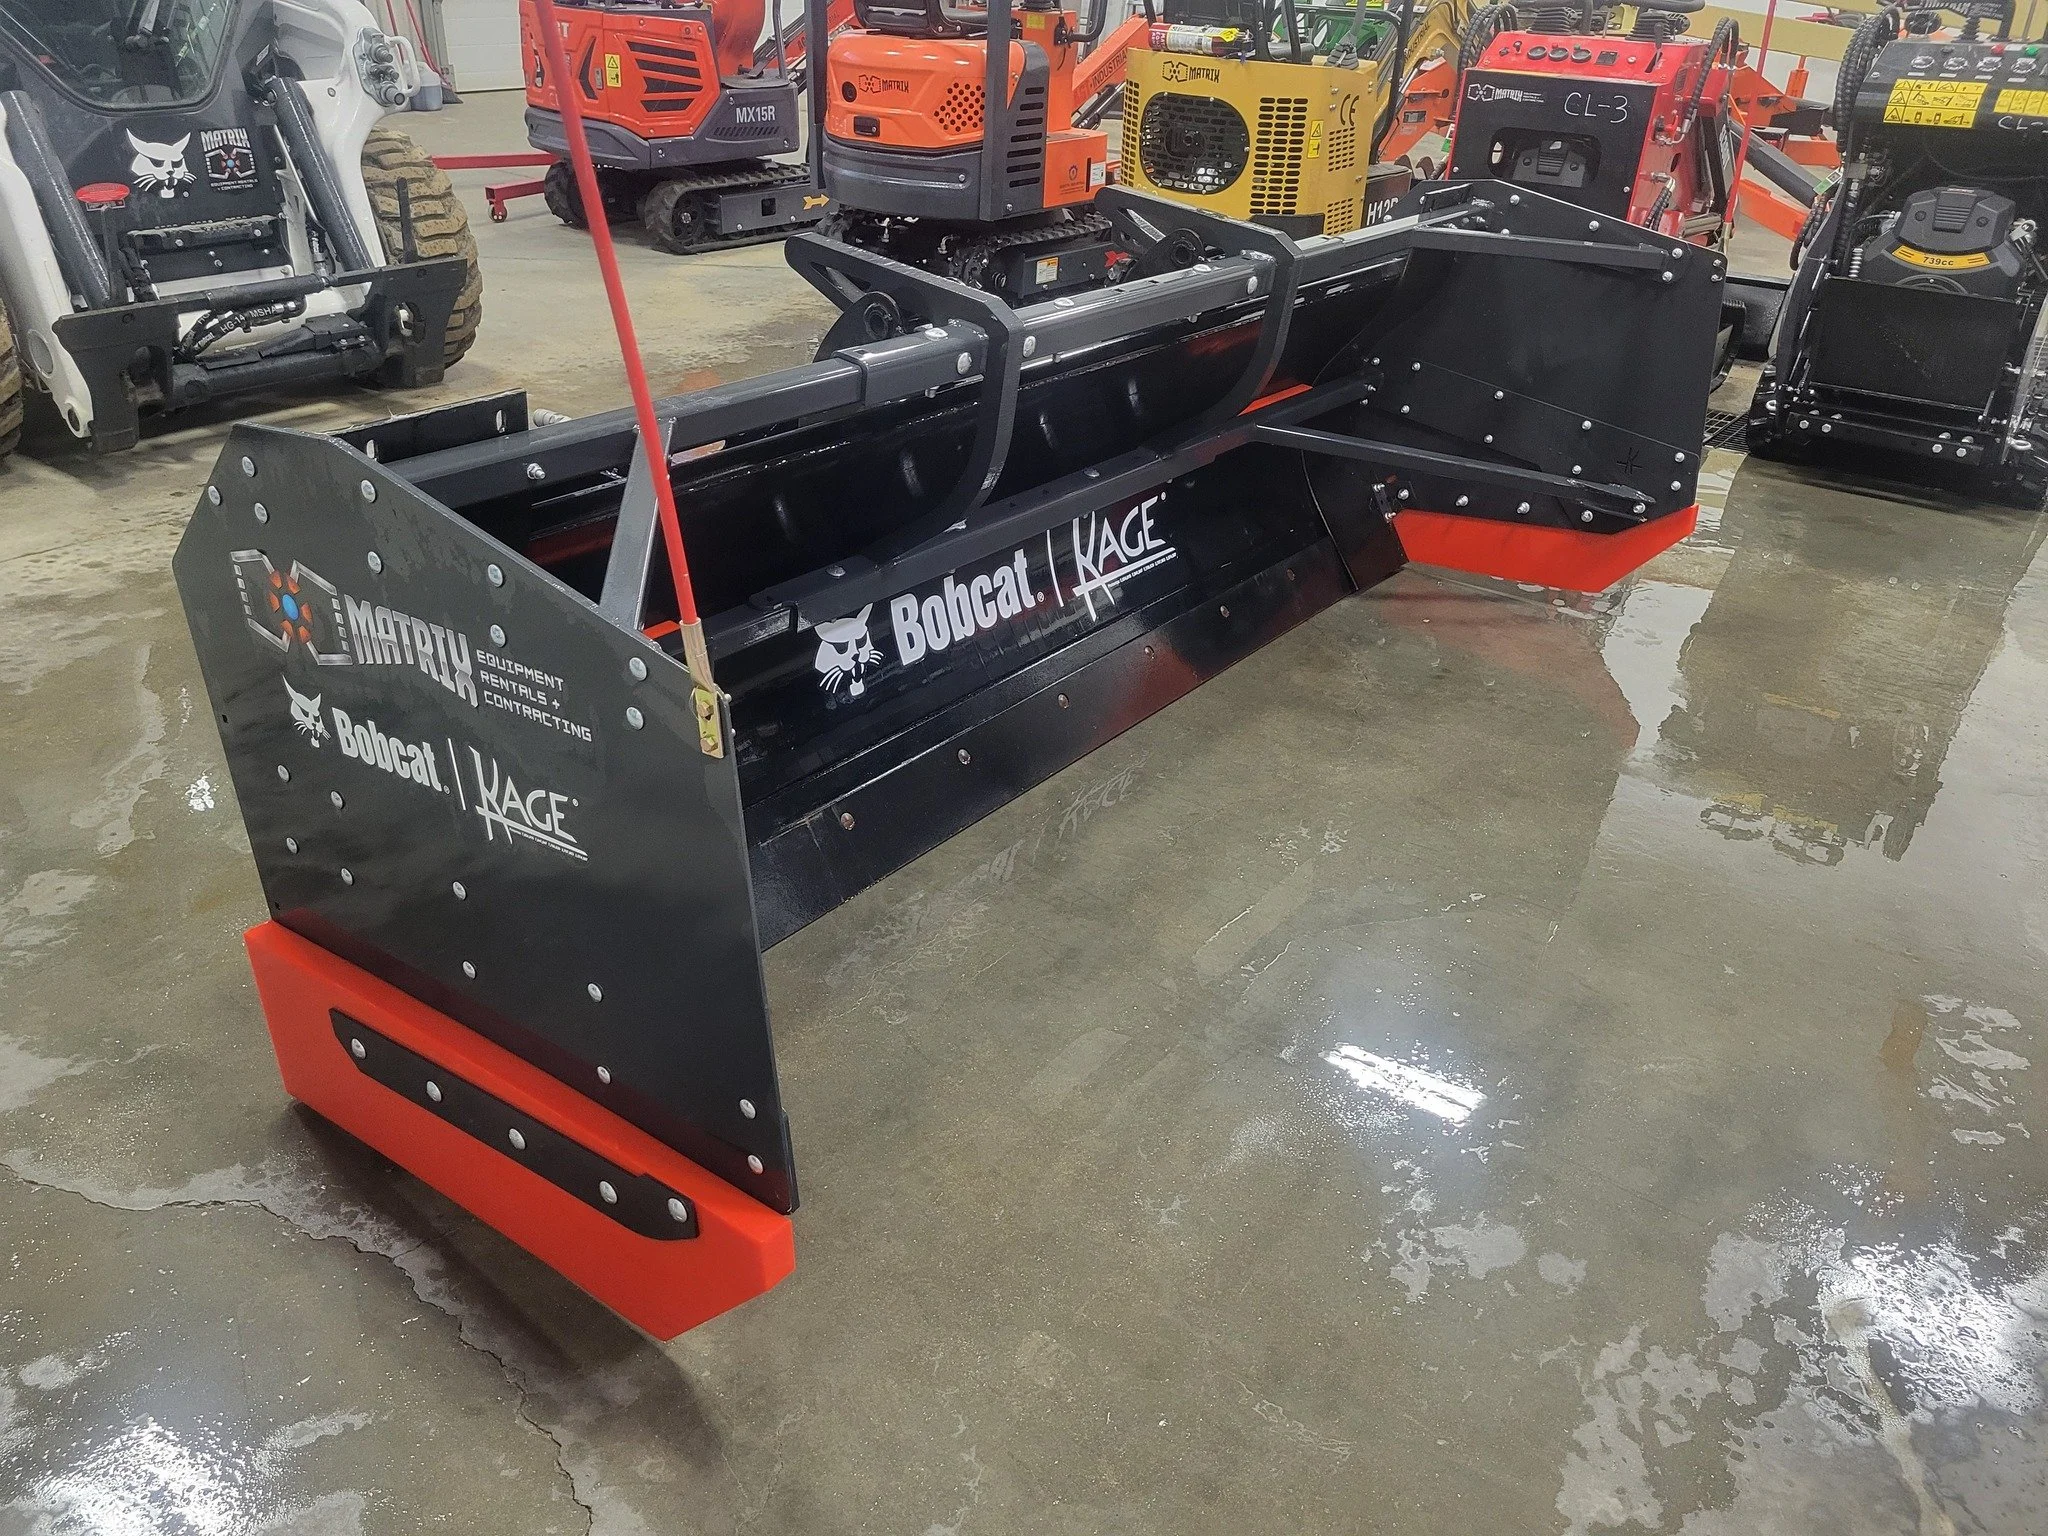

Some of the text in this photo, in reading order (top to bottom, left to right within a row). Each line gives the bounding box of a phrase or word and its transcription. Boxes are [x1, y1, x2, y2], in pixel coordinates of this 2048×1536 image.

[881, 79, 909, 93] MATRIX
[1188, 66, 1220, 83] MATRIX
[1340, 93, 1360, 126] CE
[1494, 88, 1523, 103] MATRIX
[1564, 92, 1628, 124] CL-3
[736, 105, 776, 124] MX15R
[1998, 115, 2048, 134] CL-
[200, 127, 251, 152] MATRIX
[1923, 256, 1954, 266] 739cc
[890, 495, 1168, 666] Bobcat KAGE
[344, 593, 479, 708] MATRIX
[476, 649, 564, 691] EQUIPMENT
[480, 670, 548, 706] RENTALS
[483, 690, 592, 742] CONTRACTING
[331, 706, 579, 846] Bobcat KAGE
